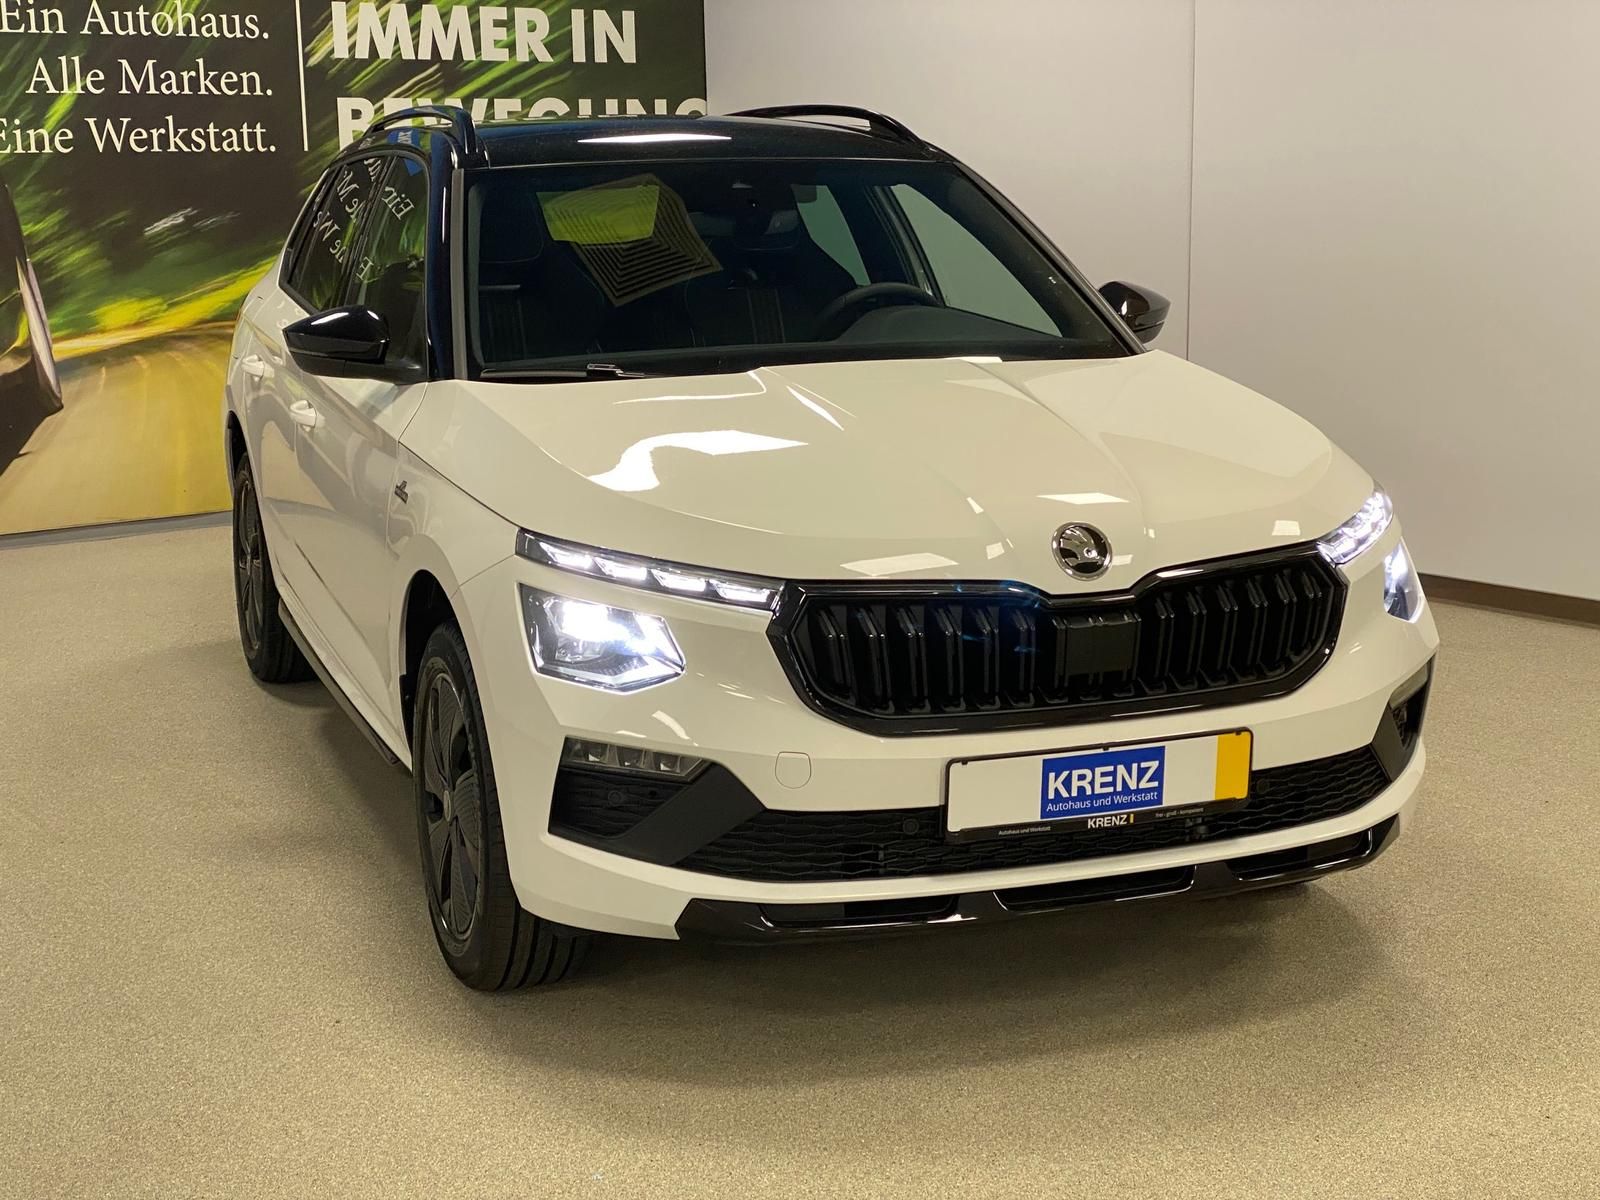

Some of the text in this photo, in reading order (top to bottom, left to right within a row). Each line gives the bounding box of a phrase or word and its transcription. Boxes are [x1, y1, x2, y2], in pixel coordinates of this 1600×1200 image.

[0, 0, 269, 39] Ein Autohaus.
[331, 1, 637, 64] IMMER IN
[26, 55, 273, 96] Alle Marken.
[84, 115, 276, 153] Werkstatt.
[1047, 760, 1160, 800] KRENZ
[1046, 791, 1158, 812] Autohaus und Werkstatt
[1087, 814, 1128, 829] KRENZ
